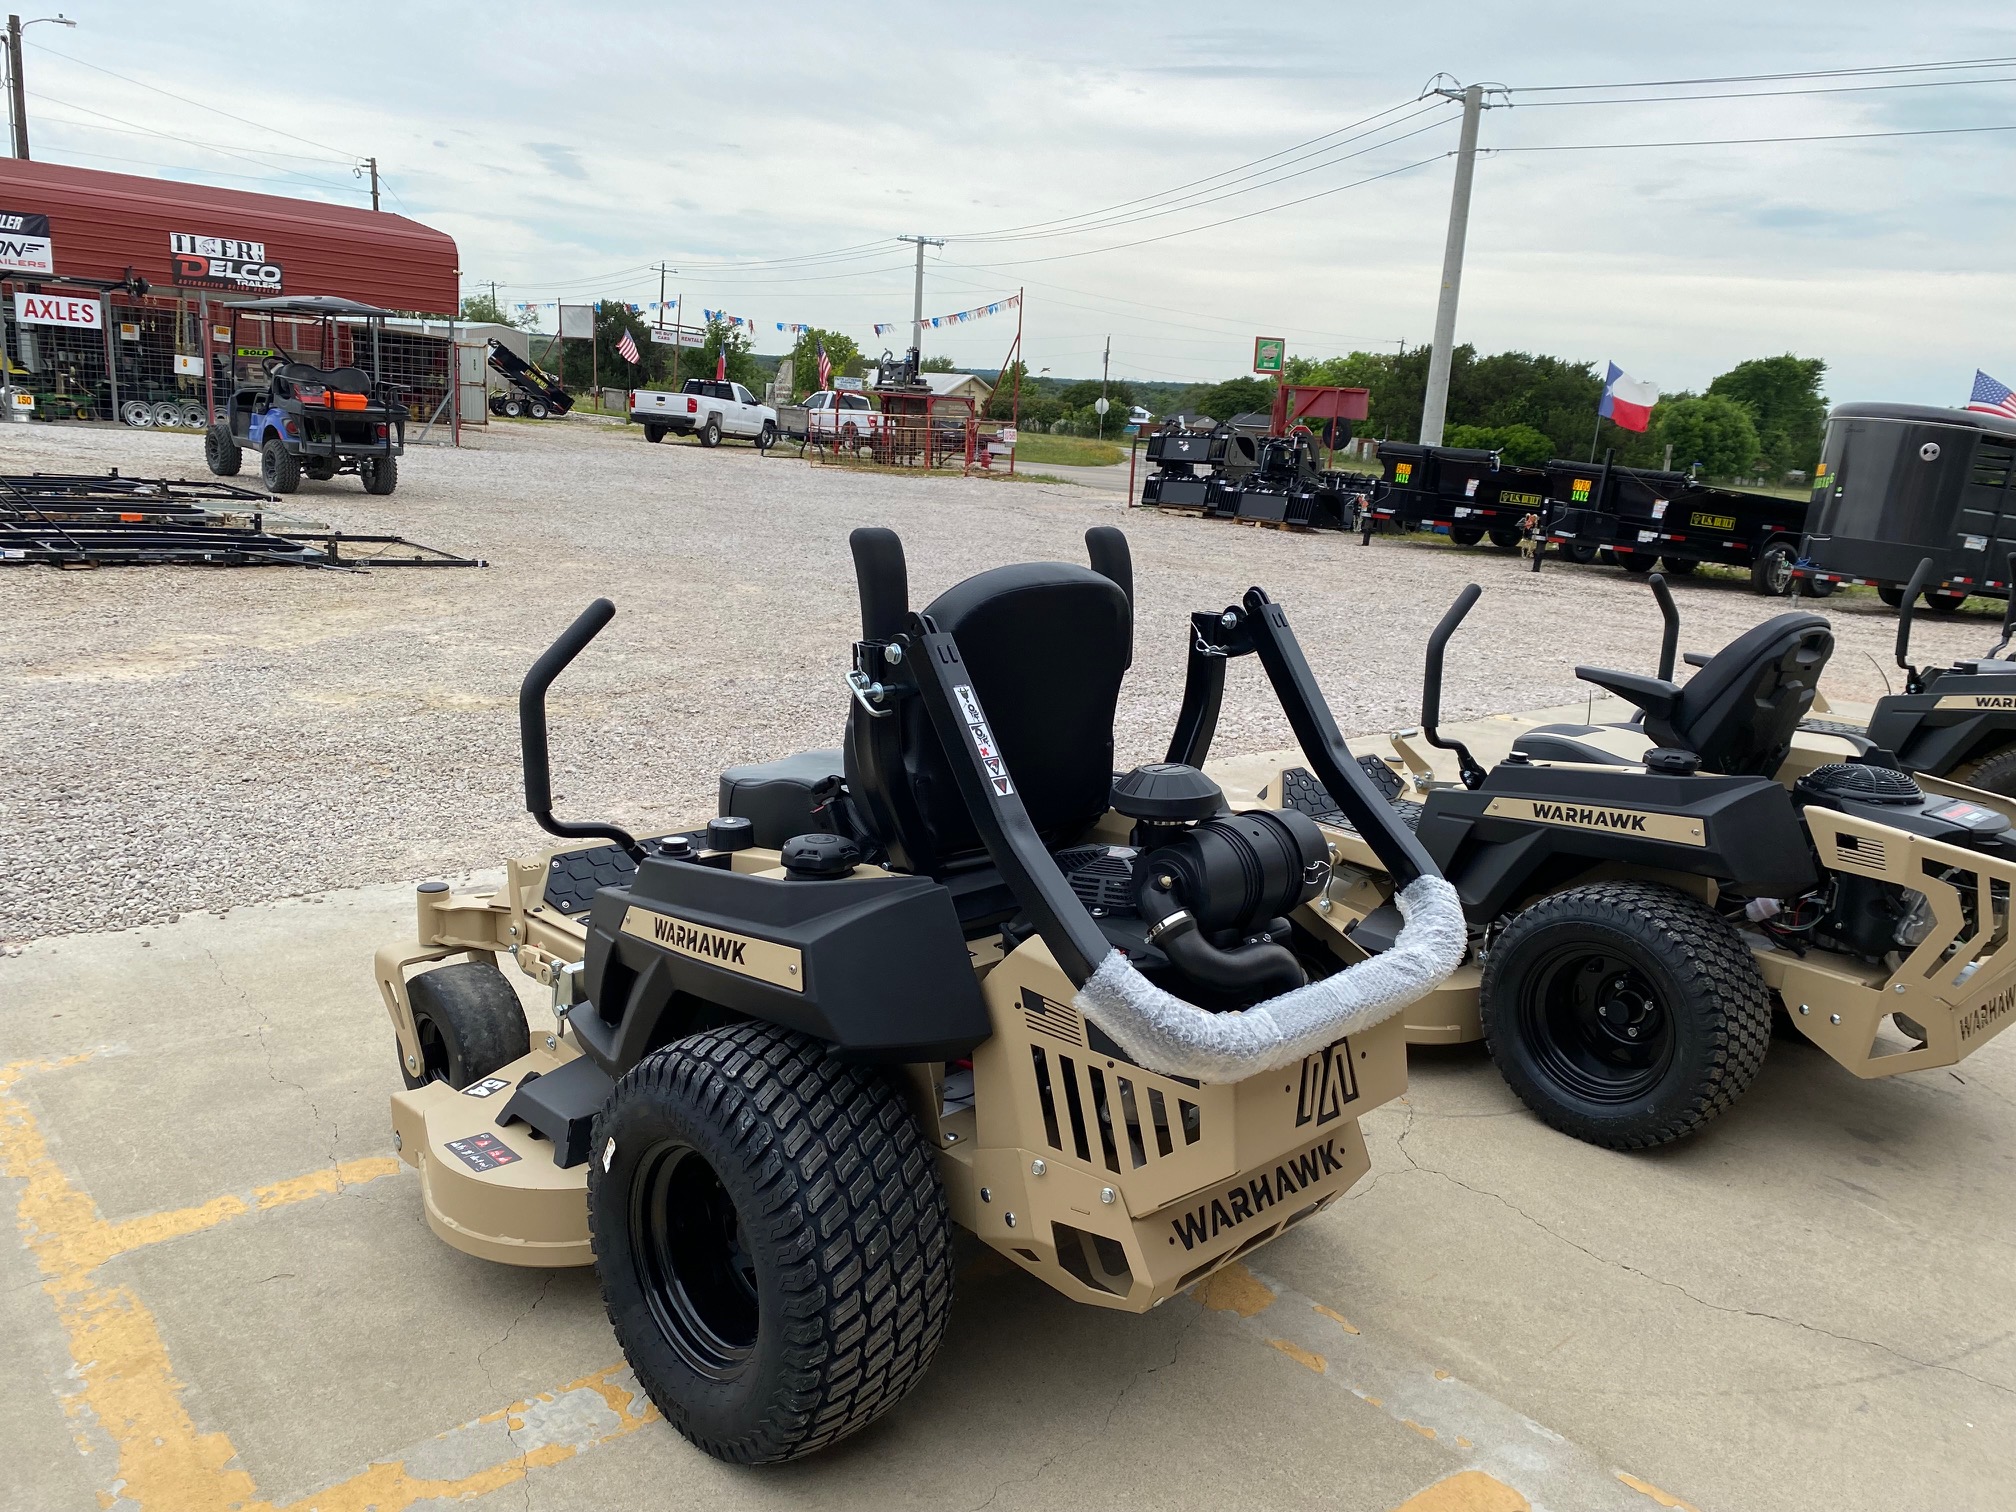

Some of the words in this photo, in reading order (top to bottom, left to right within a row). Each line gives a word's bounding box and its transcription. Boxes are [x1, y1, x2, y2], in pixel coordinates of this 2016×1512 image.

[0, 214, 24, 230] LER
[175, 254, 281, 282] DELCO
[235, 278, 282, 290] TRAILERS
[23, 298, 95, 324] AXLES
[681, 336, 703, 344] RENTALS
[16, 395, 32, 406] 150
[1714, 517, 1735, 528] BUILT
[1976, 697, 2016, 708] WAR
[1533, 802, 1648, 832] WARHAWK
[654, 916, 747, 966] WARHAWK
[1171, 1139, 1343, 1251] WARHAWK
